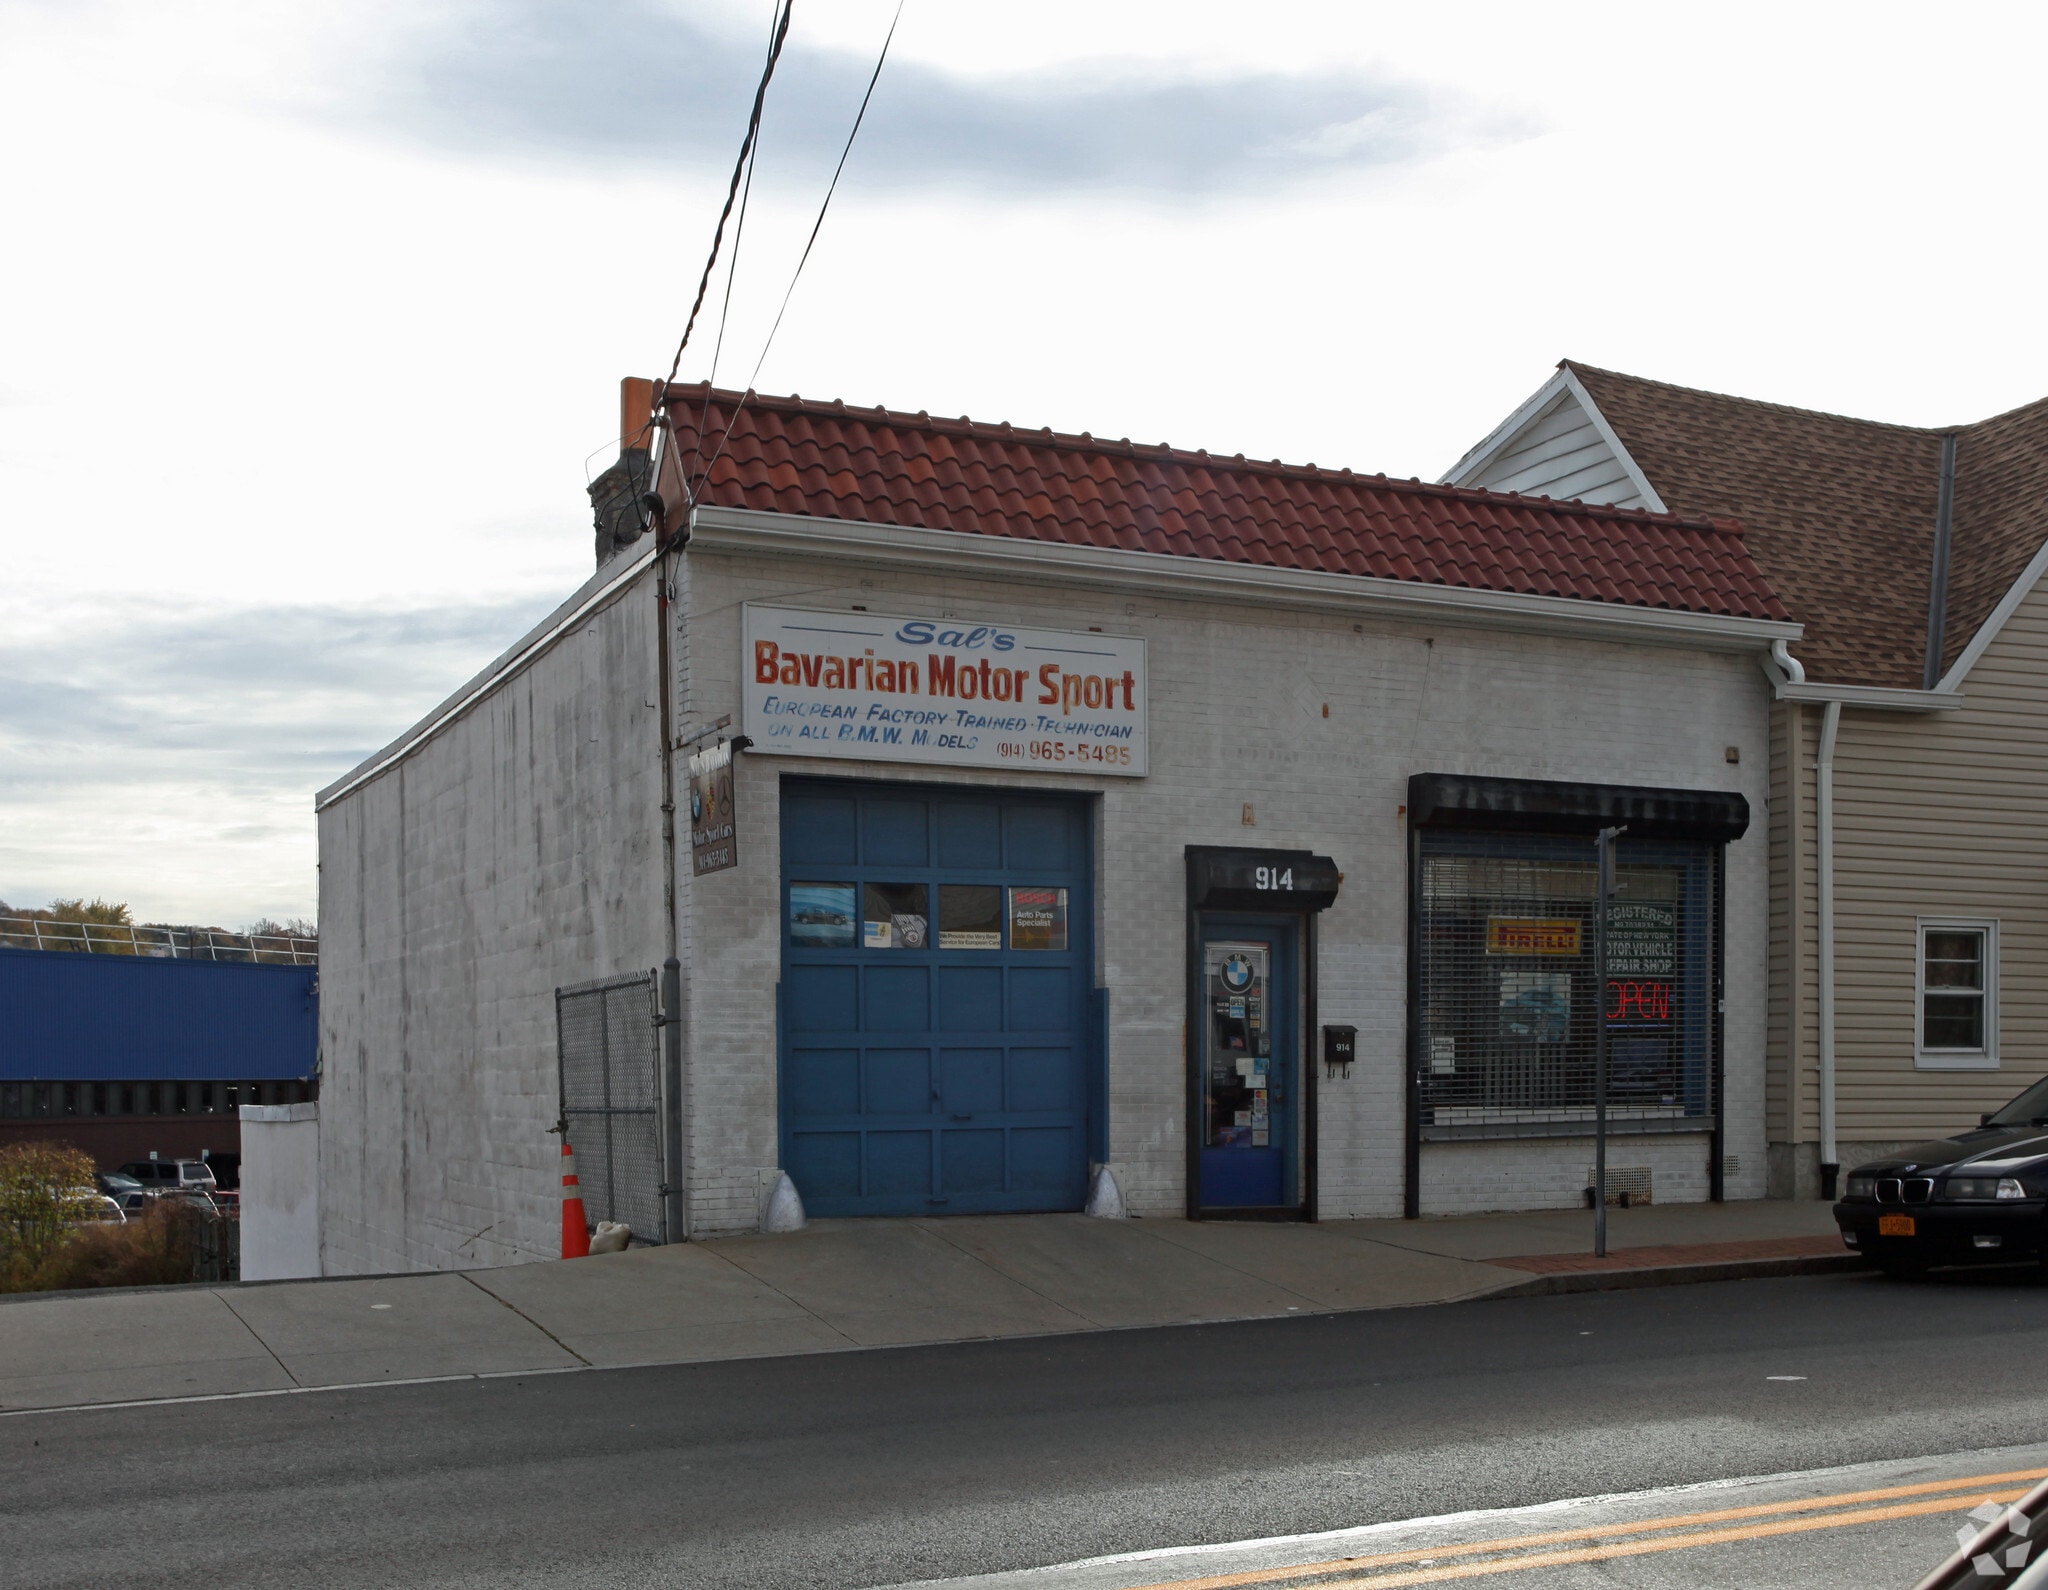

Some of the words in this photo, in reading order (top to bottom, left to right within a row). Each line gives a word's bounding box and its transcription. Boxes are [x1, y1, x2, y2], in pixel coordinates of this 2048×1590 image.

[895, 621, 1015, 651] Sal's
[755, 639, 919, 694] Bavarian
[928, 653, 1029, 703] Motor
[1038, 663, 1135, 715] Sport
[762, 696, 857, 720] EUROPEAN
[866, 703, 948, 725] FACTORY
[956, 709, 1027, 732] TRAINED
[768, 722, 794, 737] ON
[798, 724, 830, 740] ALL
[838, 723, 903, 744] B.M.W.
[996, 741, 1025, 760] (914)
[1029, 740, 1131, 766] 965-5485
[1255, 866, 1293, 890] 914
[1015, 892, 1057, 904] BOSCH
[1016, 911, 1034, 919] Auto
[1035, 911, 1054, 919] Parts
[1016, 918, 1051, 927] Specialist
[1596, 905, 1673, 926] EGISTERED
[1498, 927, 1576, 948] PIRELLI
[1606, 931, 1623, 939] TATE
[1597, 942, 1631, 956] OTOR
[1631, 942, 1673, 956] VEHICLE
[1224, 953, 1252, 972] BMW
[1642, 958, 1672, 973] SHOP
[1606, 980, 1670, 1019] OPEN
[1335, 1043, 1350, 1052] 914
